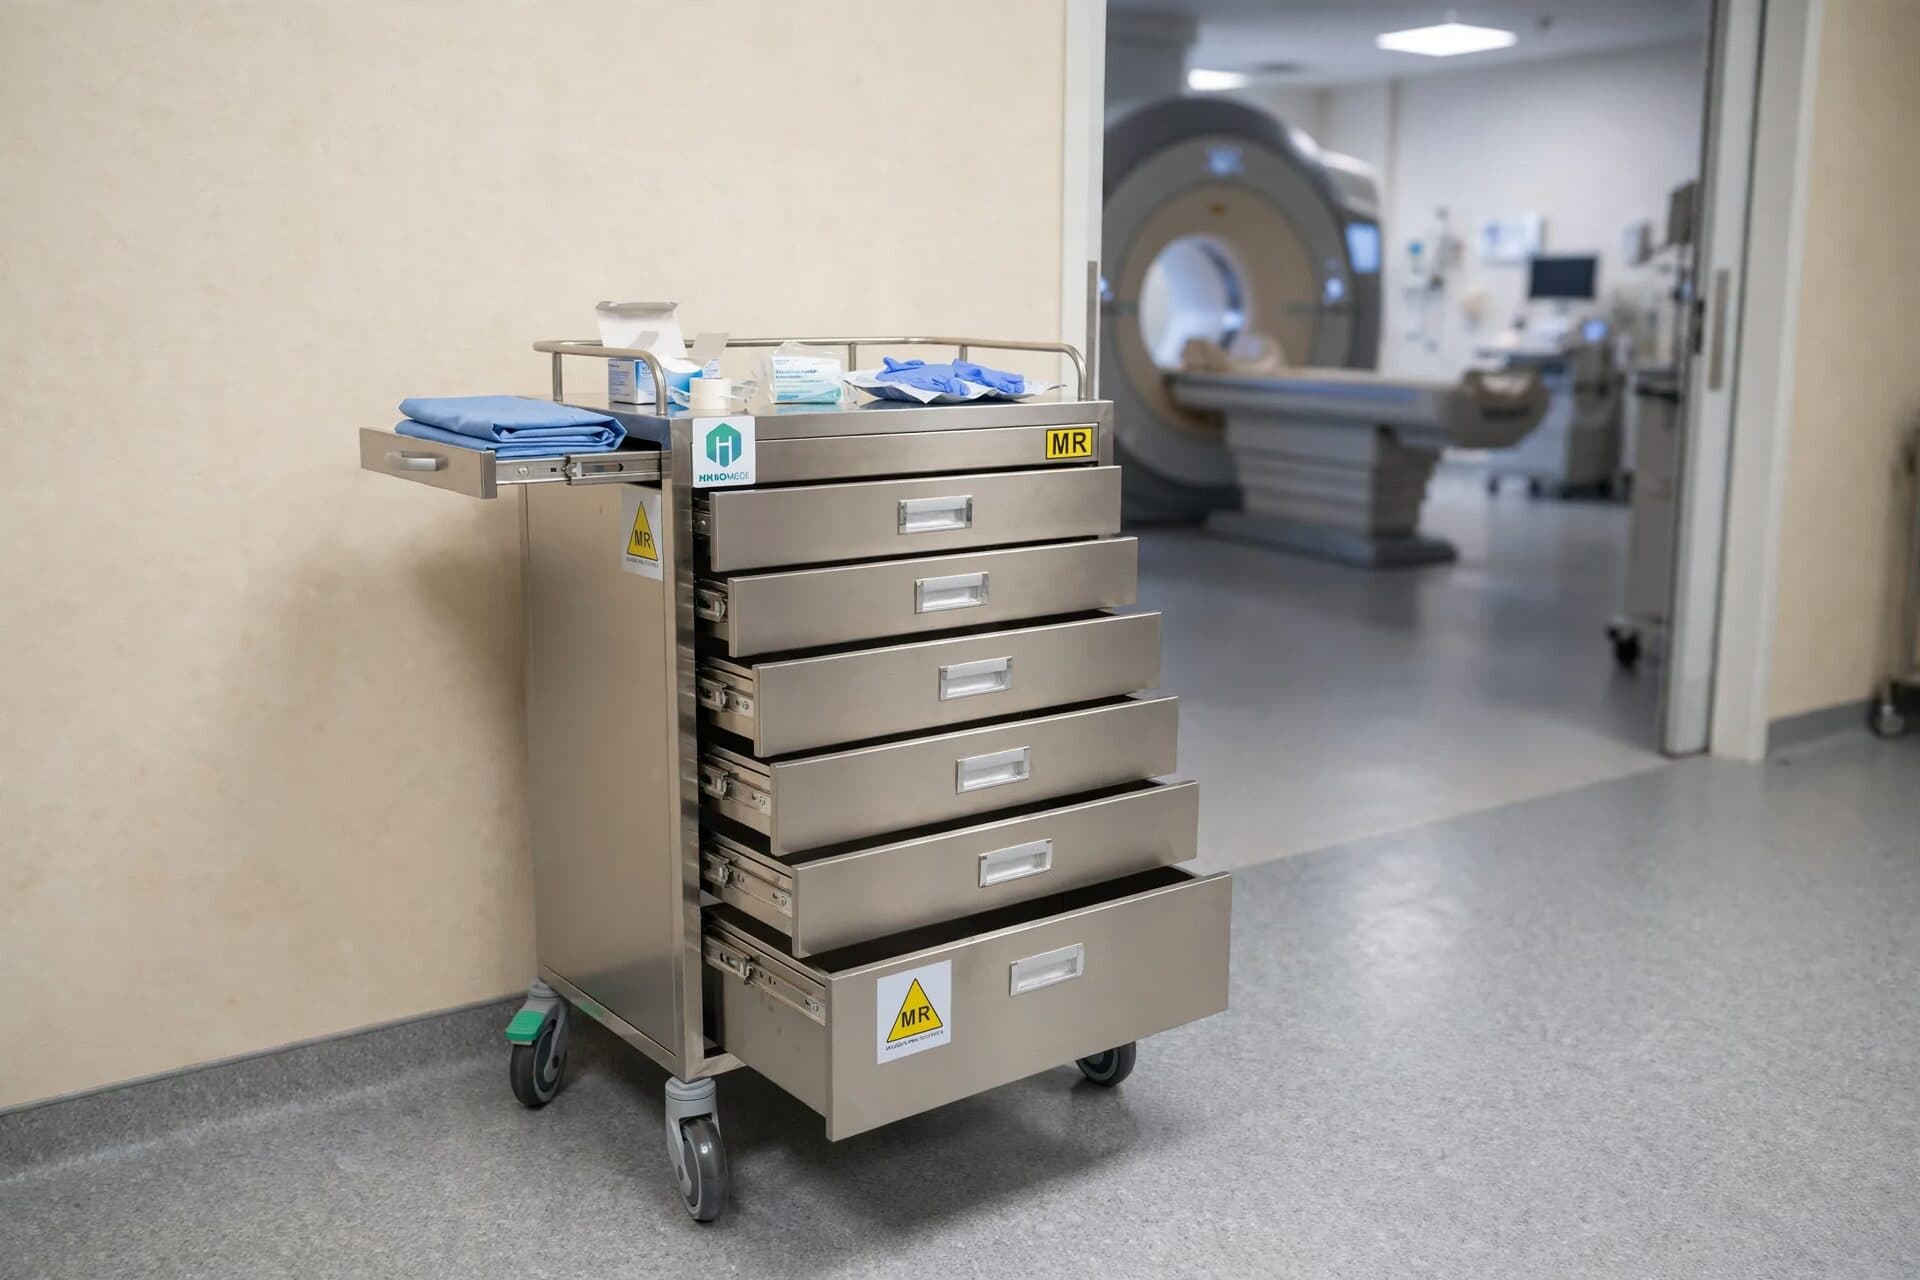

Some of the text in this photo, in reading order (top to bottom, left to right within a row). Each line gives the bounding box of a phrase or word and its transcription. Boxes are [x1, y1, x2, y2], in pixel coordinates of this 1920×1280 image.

[1052, 432, 1087, 455] MR
[634, 529, 651, 549] MR
[901, 1005, 931, 1028] MR
